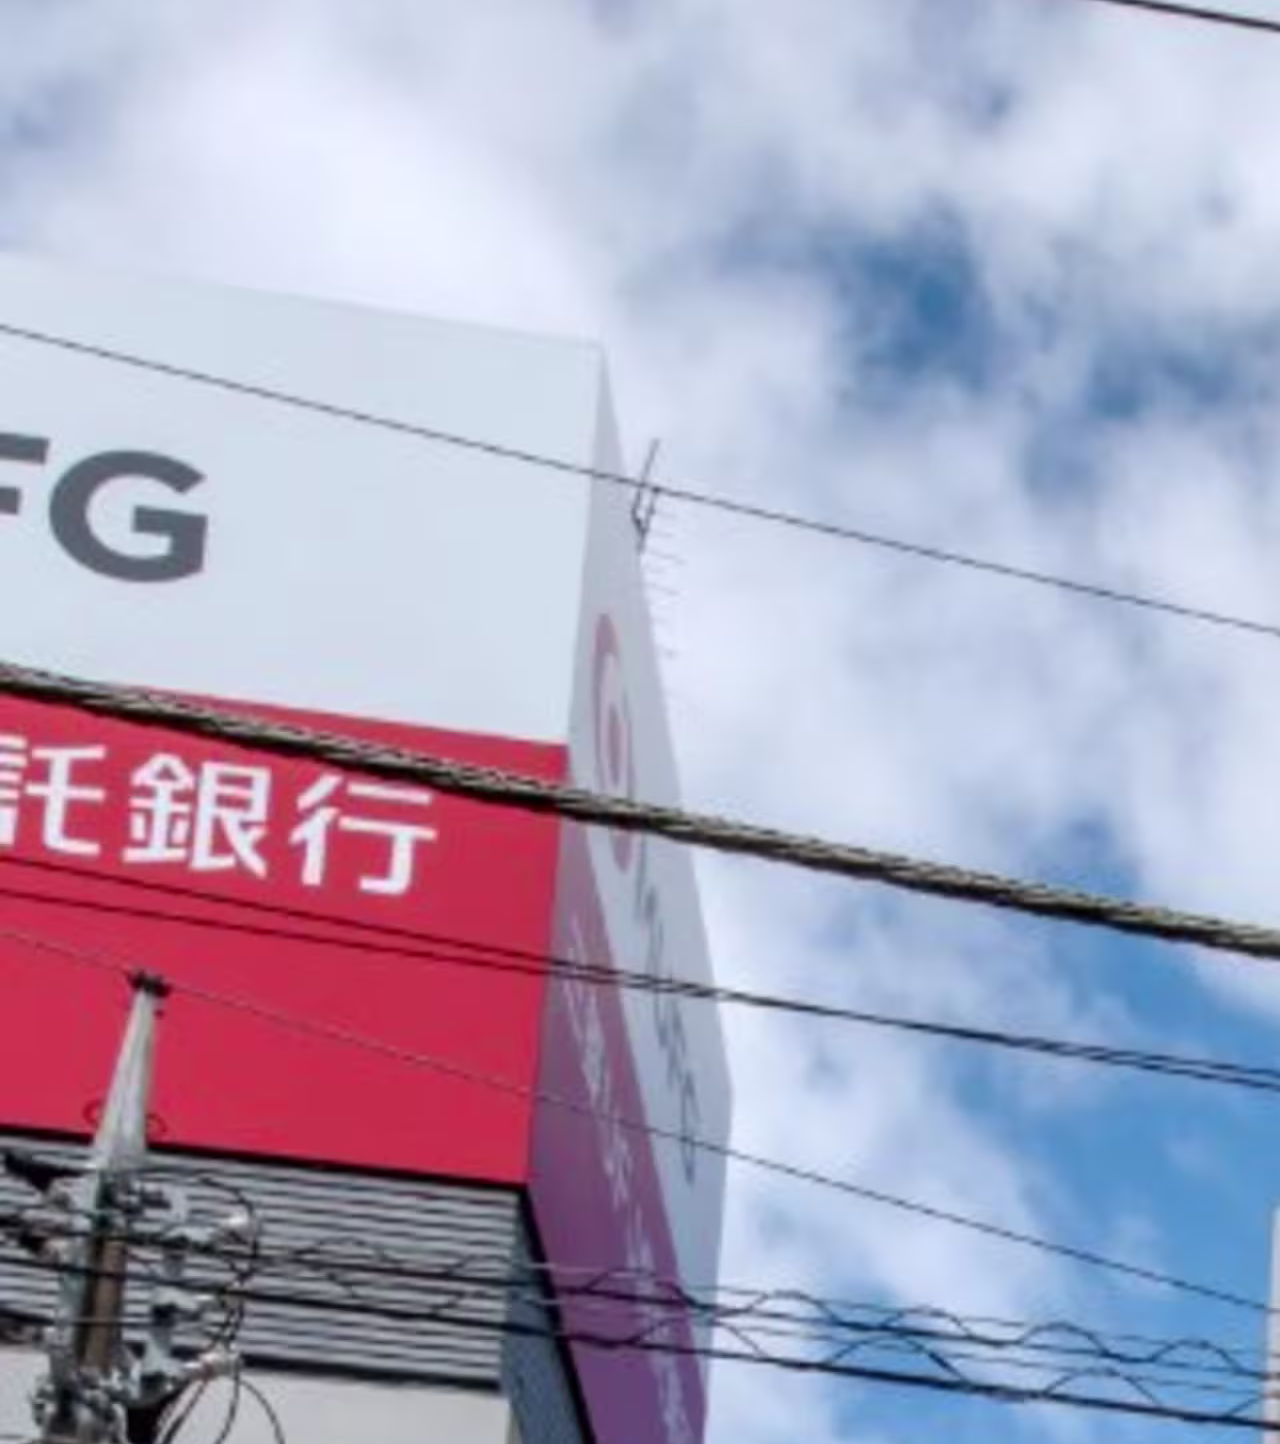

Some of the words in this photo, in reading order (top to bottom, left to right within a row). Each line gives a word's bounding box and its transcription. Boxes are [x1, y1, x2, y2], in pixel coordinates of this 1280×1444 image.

[0, 432, 208, 584] G
[0, 735, 438, 896] 託銀行
